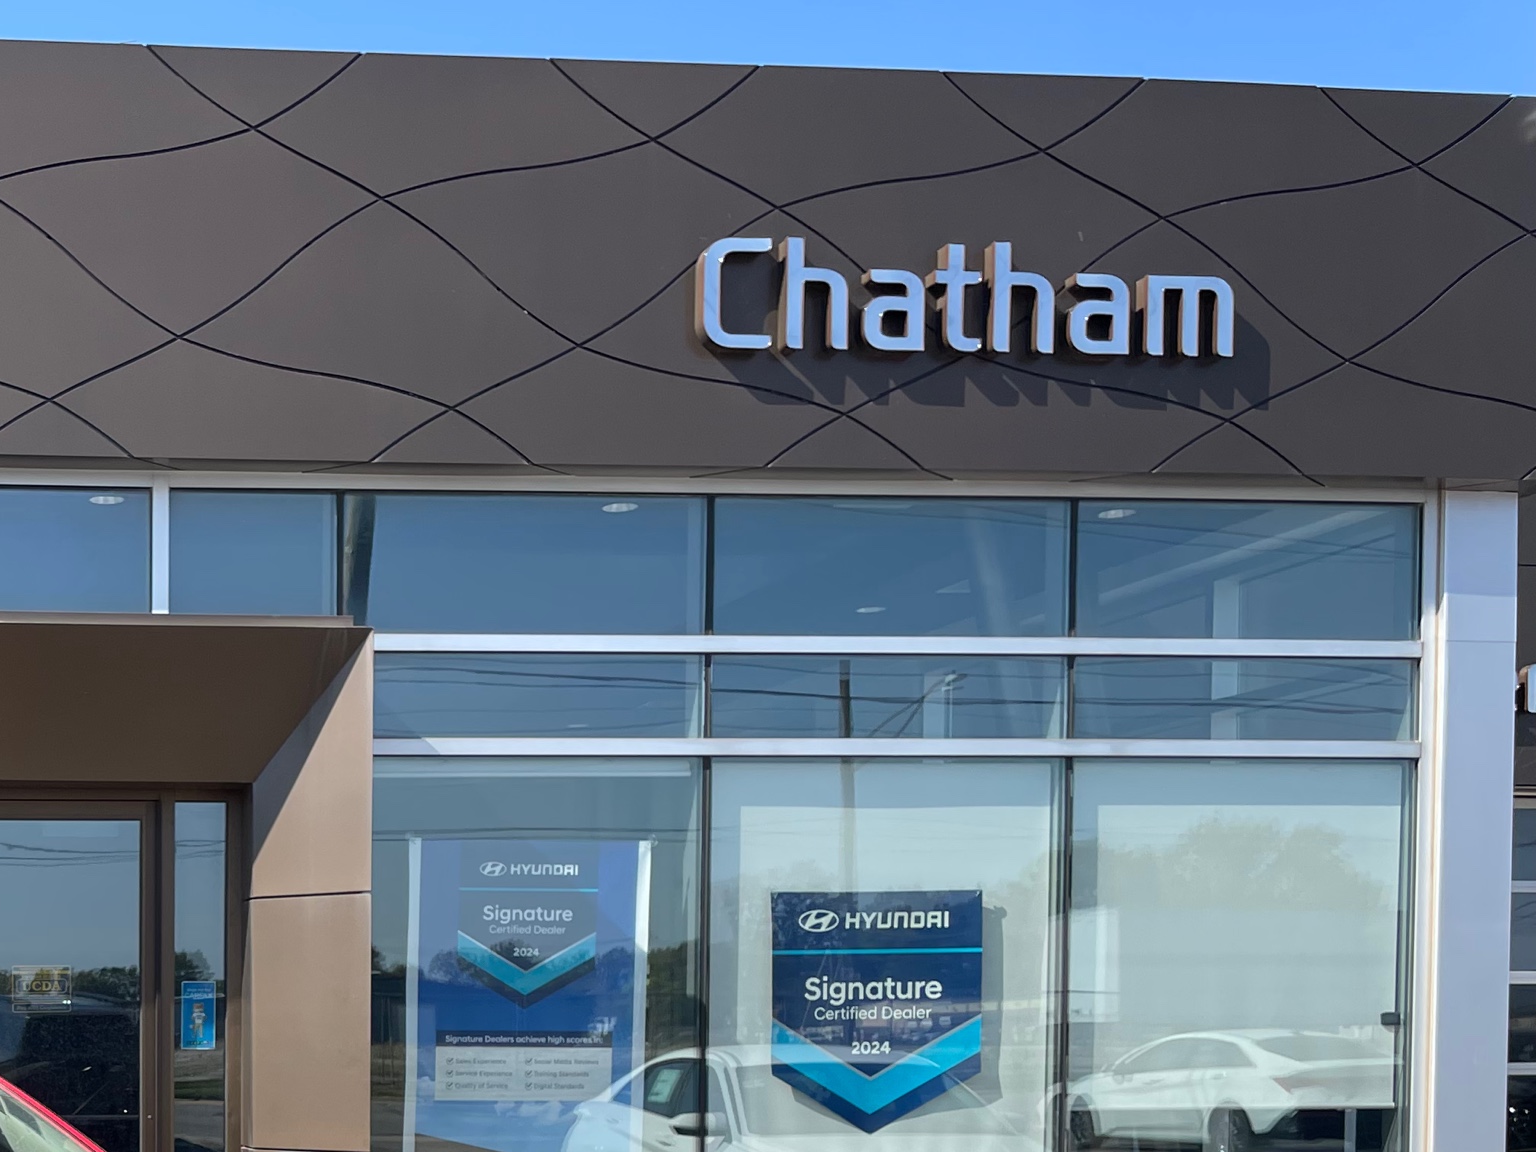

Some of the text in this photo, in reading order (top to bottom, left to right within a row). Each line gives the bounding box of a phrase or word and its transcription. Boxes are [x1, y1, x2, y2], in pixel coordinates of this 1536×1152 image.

[694, 235, 1235, 358] Chatham
[510, 863, 579, 876] HYUNDAI
[482, 905, 574, 925] Signature
[844, 911, 950, 930] HYUNDAI
[489, 925, 566, 936] Certified Dealer
[513, 947, 540, 957] 2024
[804, 976, 943, 1006] Signature
[814, 1006, 932, 1021] Certified Dealer
[445, 1035, 483, 1044] Signature
[484, 1035, 514, 1043] Dealers
[515, 1035, 546, 1044] achieve
[547, 1035, 565, 1045] high
[851, 1041, 891, 1055] 2024
